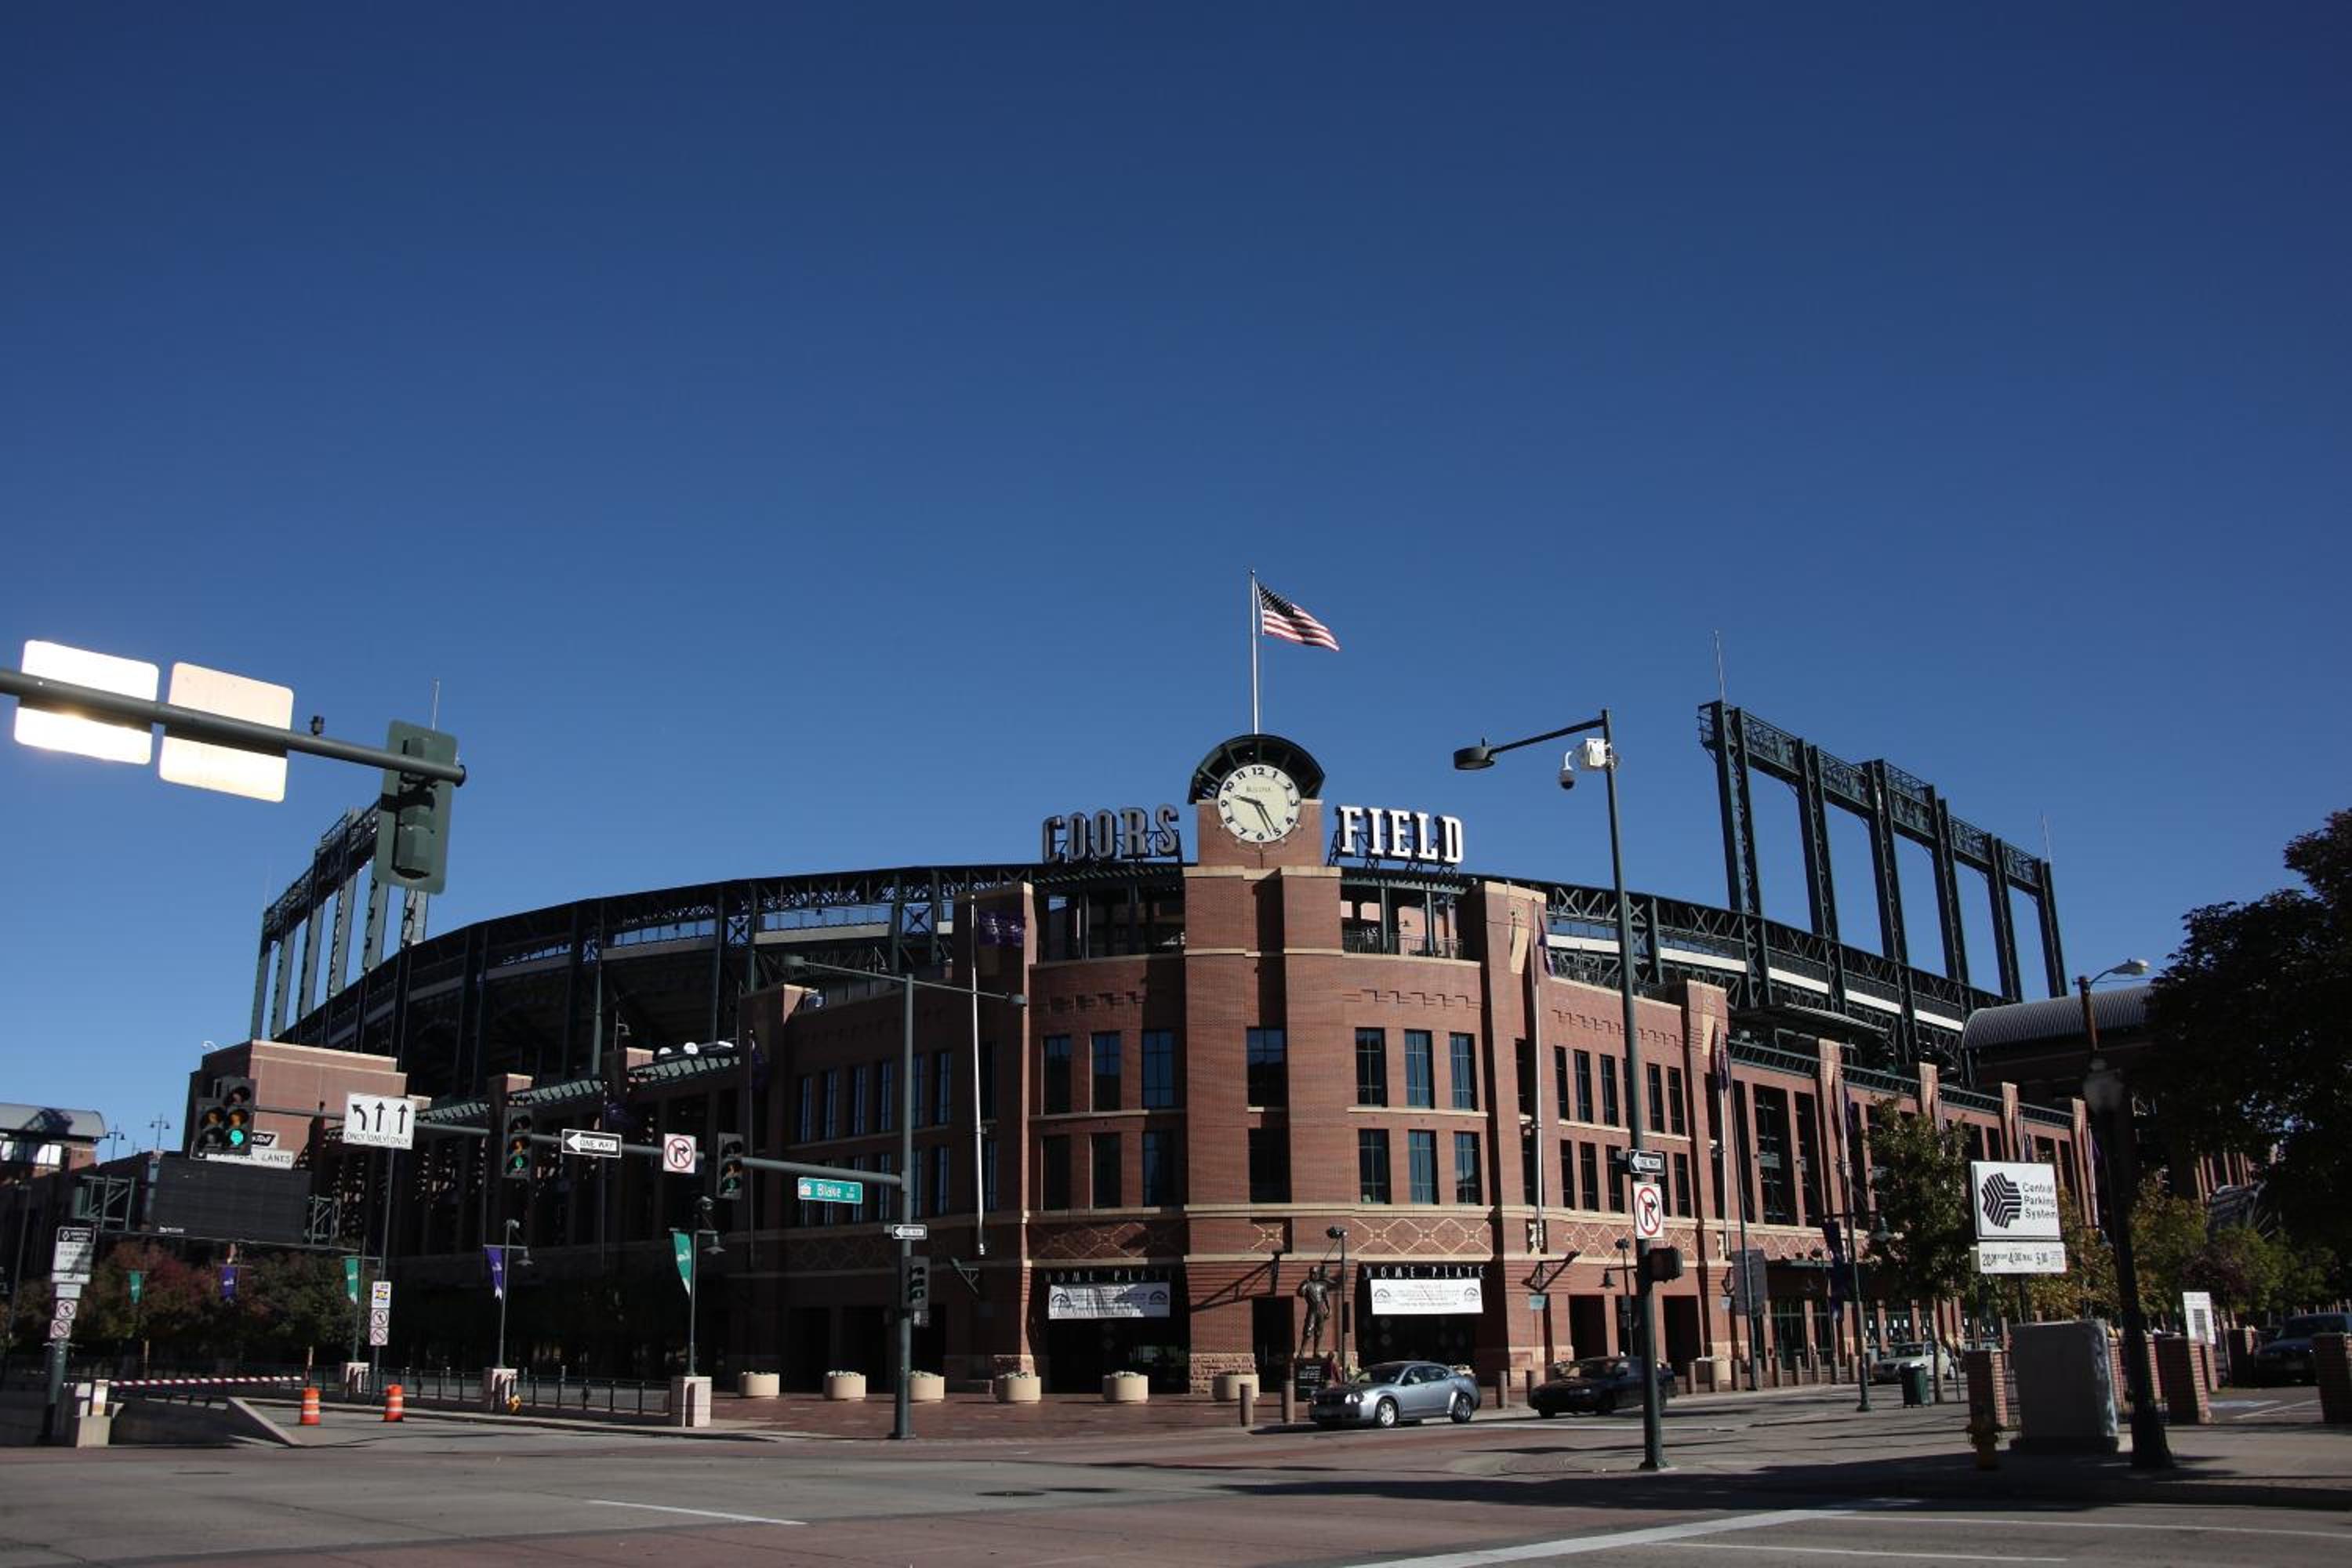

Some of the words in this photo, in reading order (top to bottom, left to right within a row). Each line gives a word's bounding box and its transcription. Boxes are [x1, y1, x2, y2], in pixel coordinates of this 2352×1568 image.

[1236, 771, 1246, 779] 11
[1251, 767, 1265, 775] 12
[1223, 781, 1235, 793] 10
[1043, 804, 1179, 864] COORS
[1337, 805, 1464, 864] FIELD
[1239, 827, 1247, 836] 7
[1273, 827, 1282, 837] 5
[346, 1131, 366, 1141] ONLY
[579, 1138, 596, 1149] ONE
[598, 1140, 614, 1149] WAY
[261, 1153, 291, 1163] LANES
[817, 1183, 841, 1198] Blake
[2022, 1182, 2053, 1193] Central
[2024, 1195, 2056, 1208] Parking
[2025, 1207, 2058, 1221] System
[1045, 1270, 1094, 1283] HOME
[1367, 1266, 1415, 1279] HOME
[1432, 1266, 1484, 1279] PLATE
